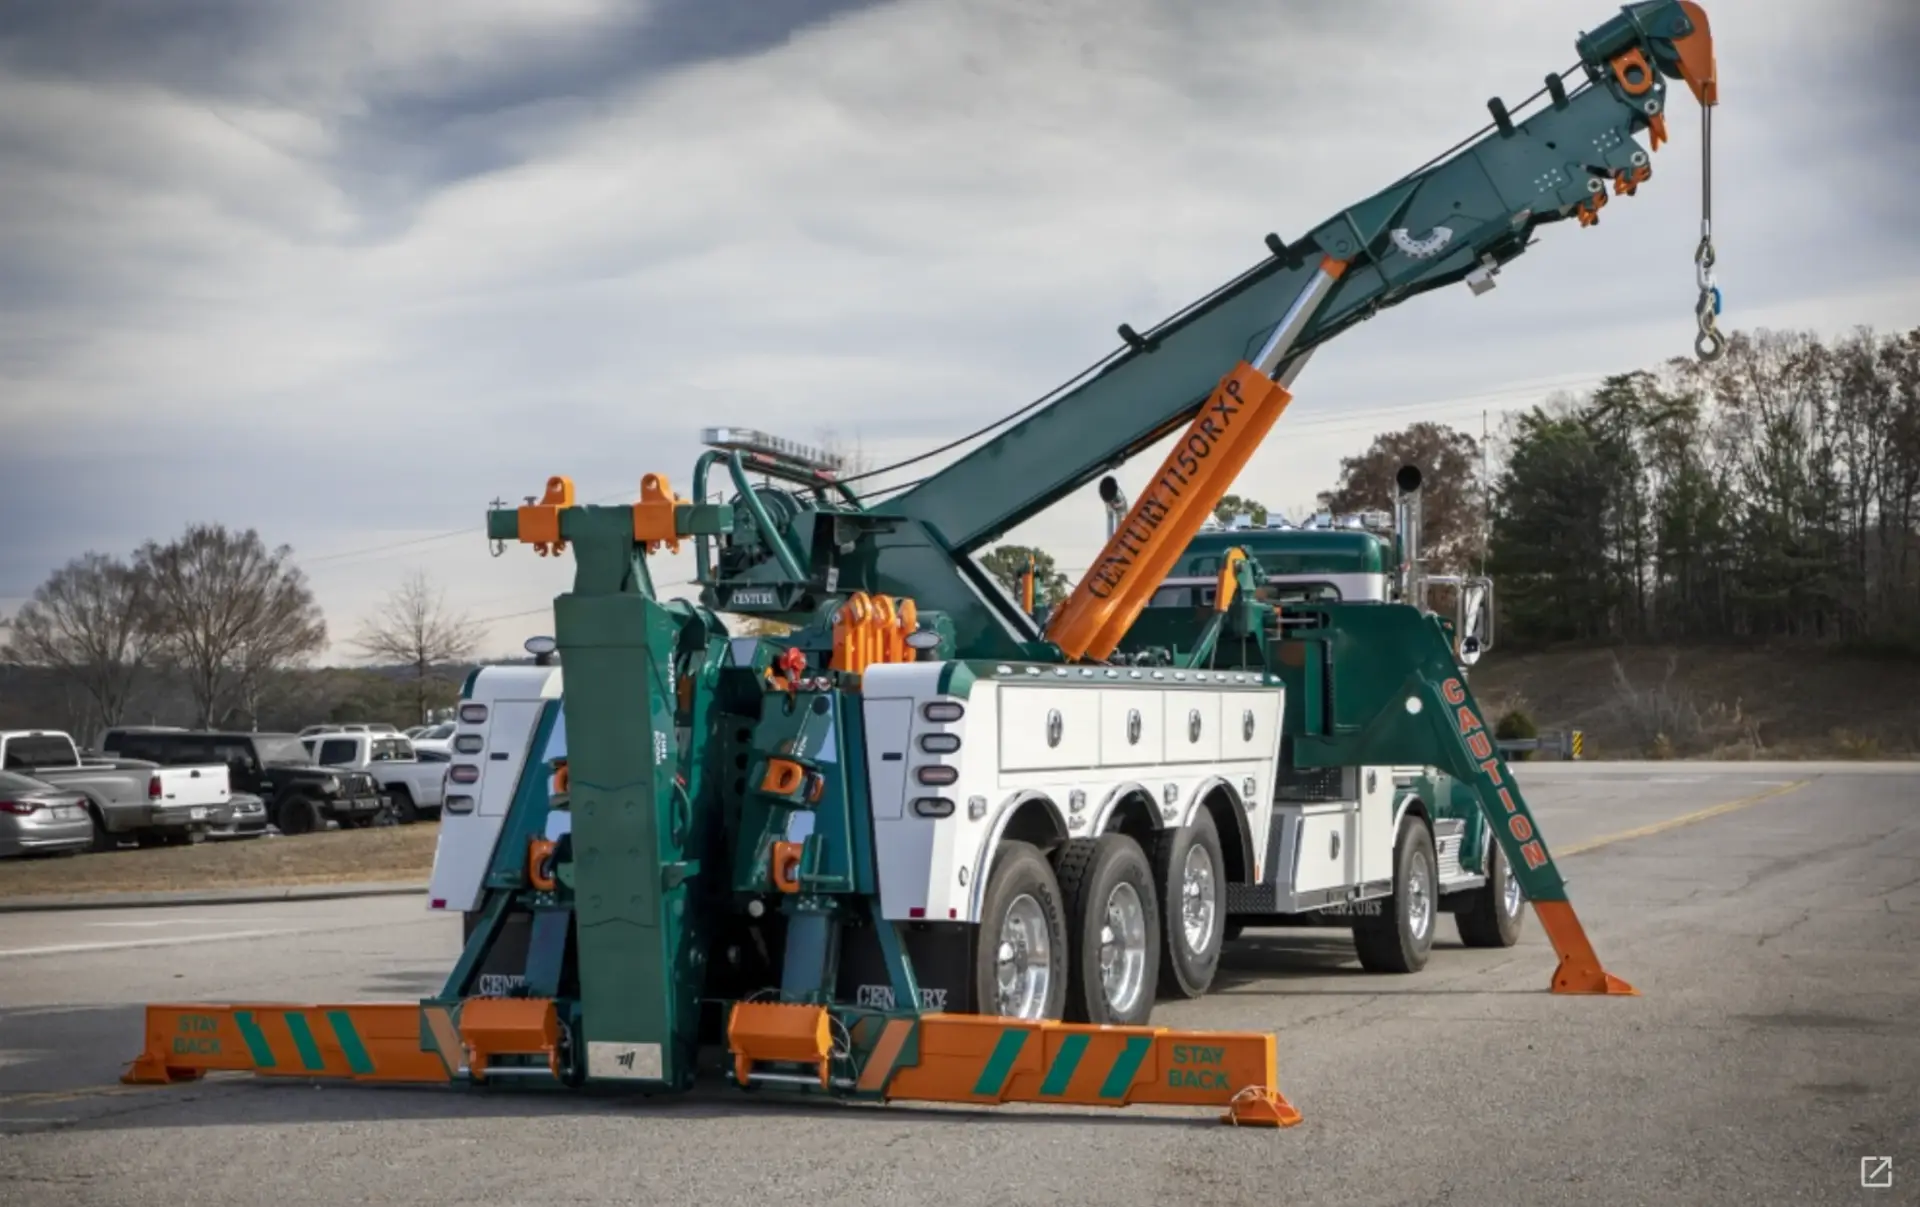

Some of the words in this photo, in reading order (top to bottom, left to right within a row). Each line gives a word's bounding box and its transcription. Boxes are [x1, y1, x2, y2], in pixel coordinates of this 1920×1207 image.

[1442, 678, 1548, 870] CAUTION
[480, 973, 526, 995] CENT
[857, 984, 947, 1010] CENRY
[178, 1014, 218, 1034] STAY
[172, 1036, 222, 1056] BACK
[1173, 1044, 1226, 1065] STAY
[1168, 1068, 1231, 1091] BACK
